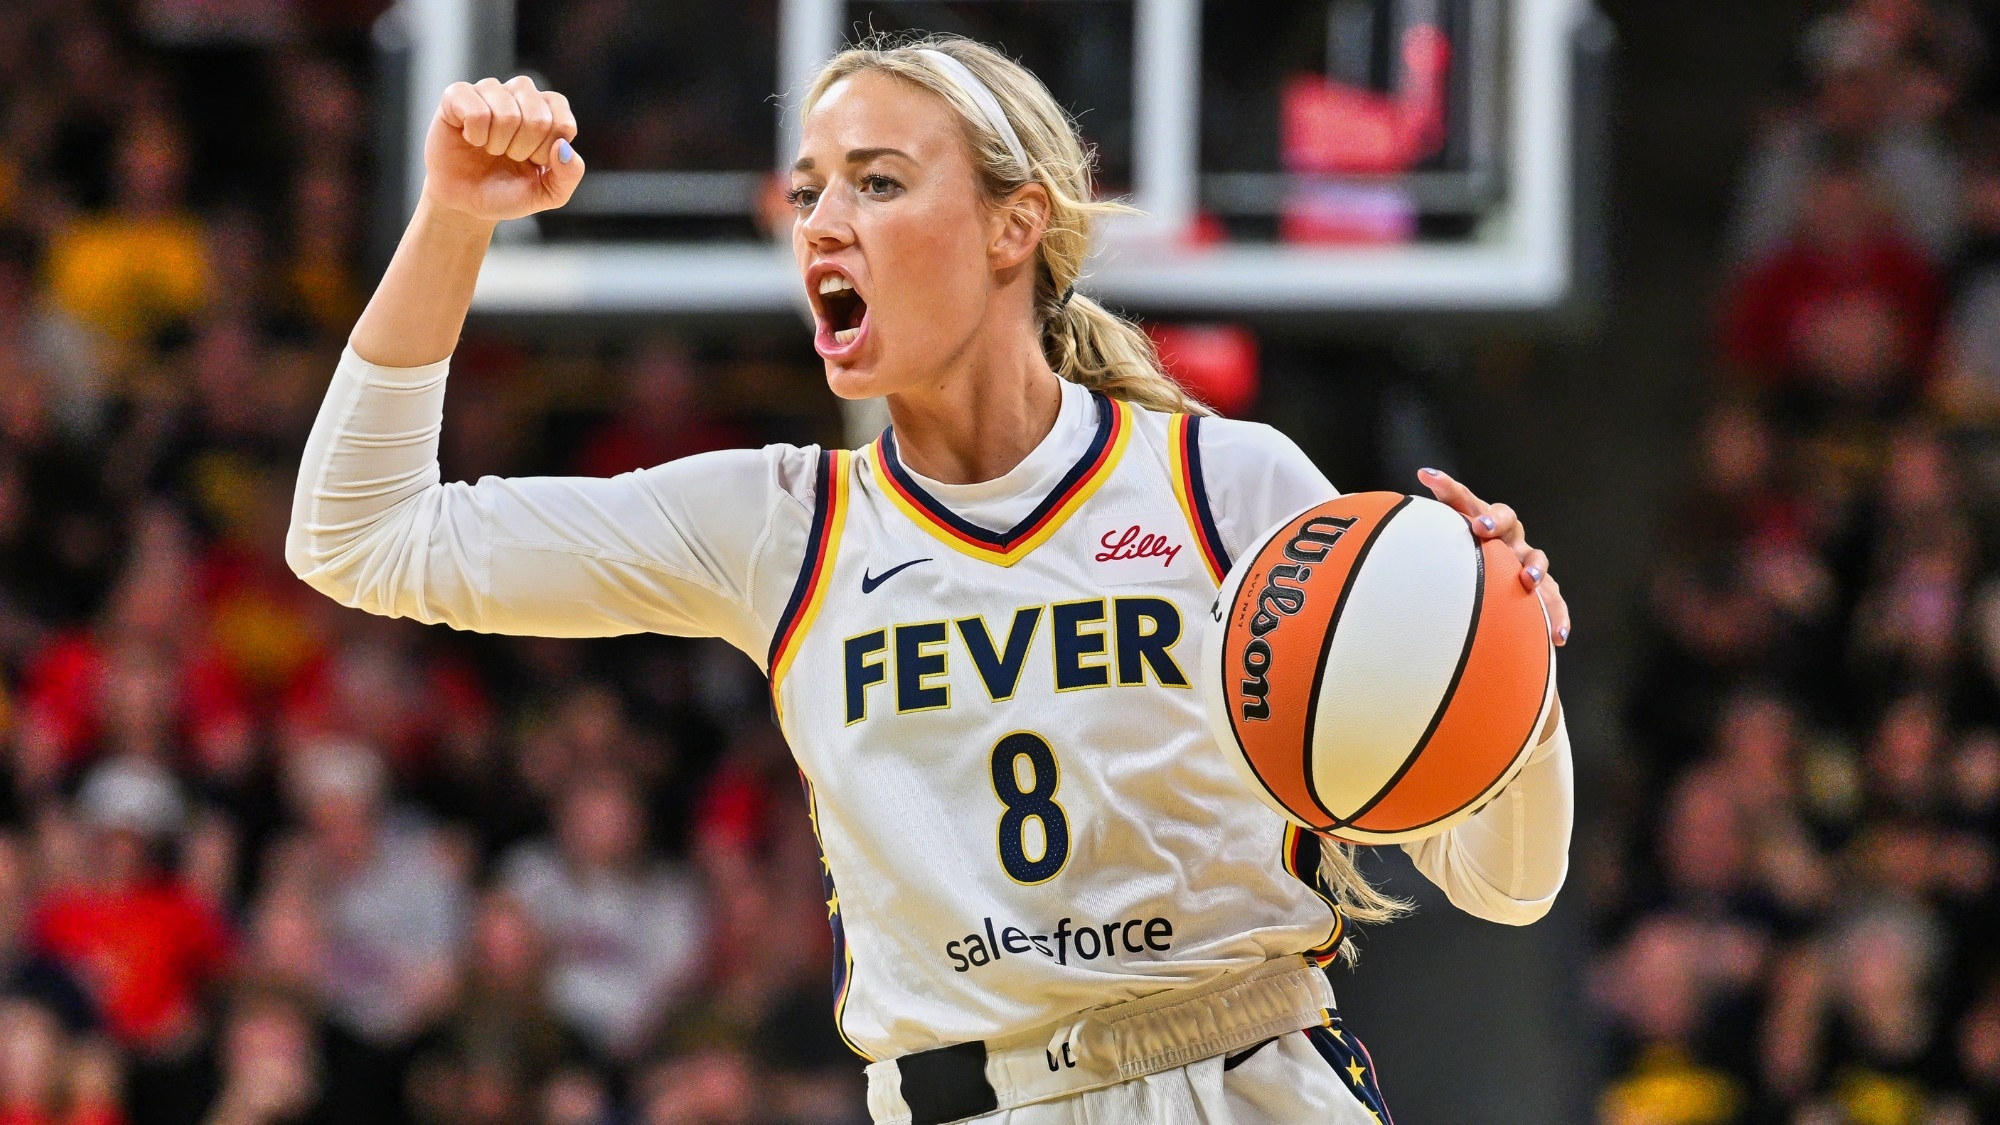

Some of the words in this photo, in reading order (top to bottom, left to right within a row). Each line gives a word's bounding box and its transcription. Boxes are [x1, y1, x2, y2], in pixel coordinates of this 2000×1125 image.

[1095, 525, 1181, 567] Lilly
[1247, 573, 1261, 598] EVO
[1237, 602, 1249, 628] NXT
[1240, 514, 1360, 723] Wilson
[843, 596, 1193, 728] FEVER
[988, 729, 1071, 886] 8
[945, 916, 1174, 973] salesforce
